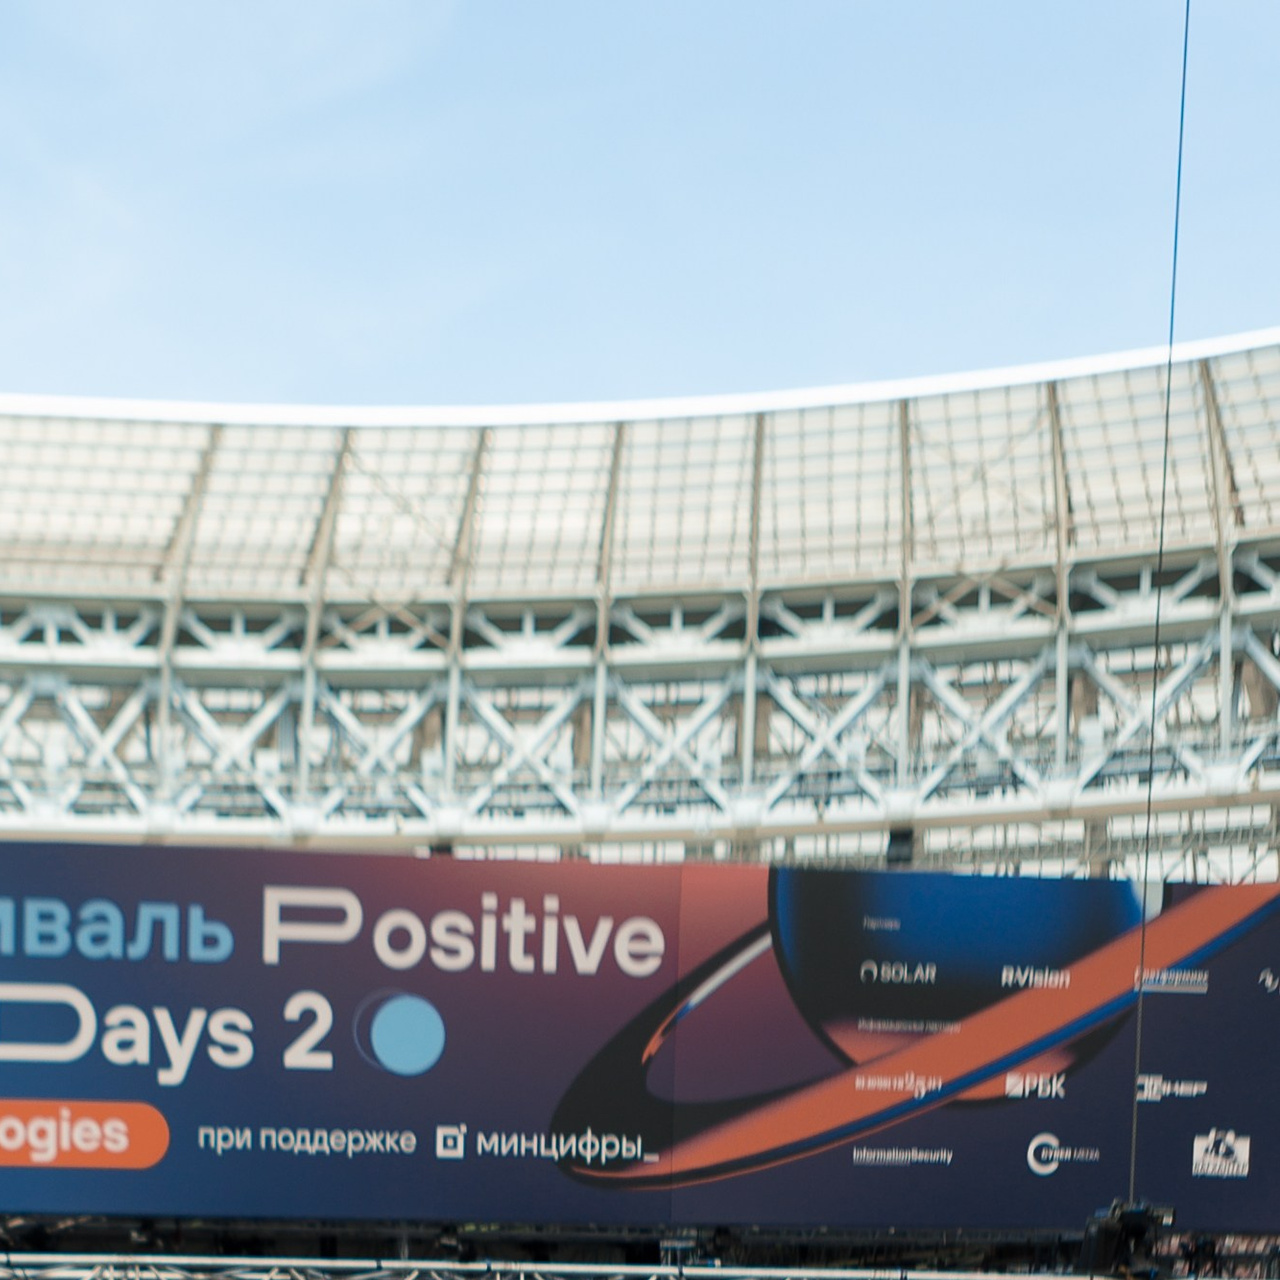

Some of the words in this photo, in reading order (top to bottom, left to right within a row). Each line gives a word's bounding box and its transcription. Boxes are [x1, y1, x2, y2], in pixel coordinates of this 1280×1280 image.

[262, 885, 666, 976] Positive
[880, 962, 937, 985] SOLAR
[282, 990, 334, 1071] 2
[198, 1125, 252, 1156] при
[260, 1125, 417, 1160] поддержке
